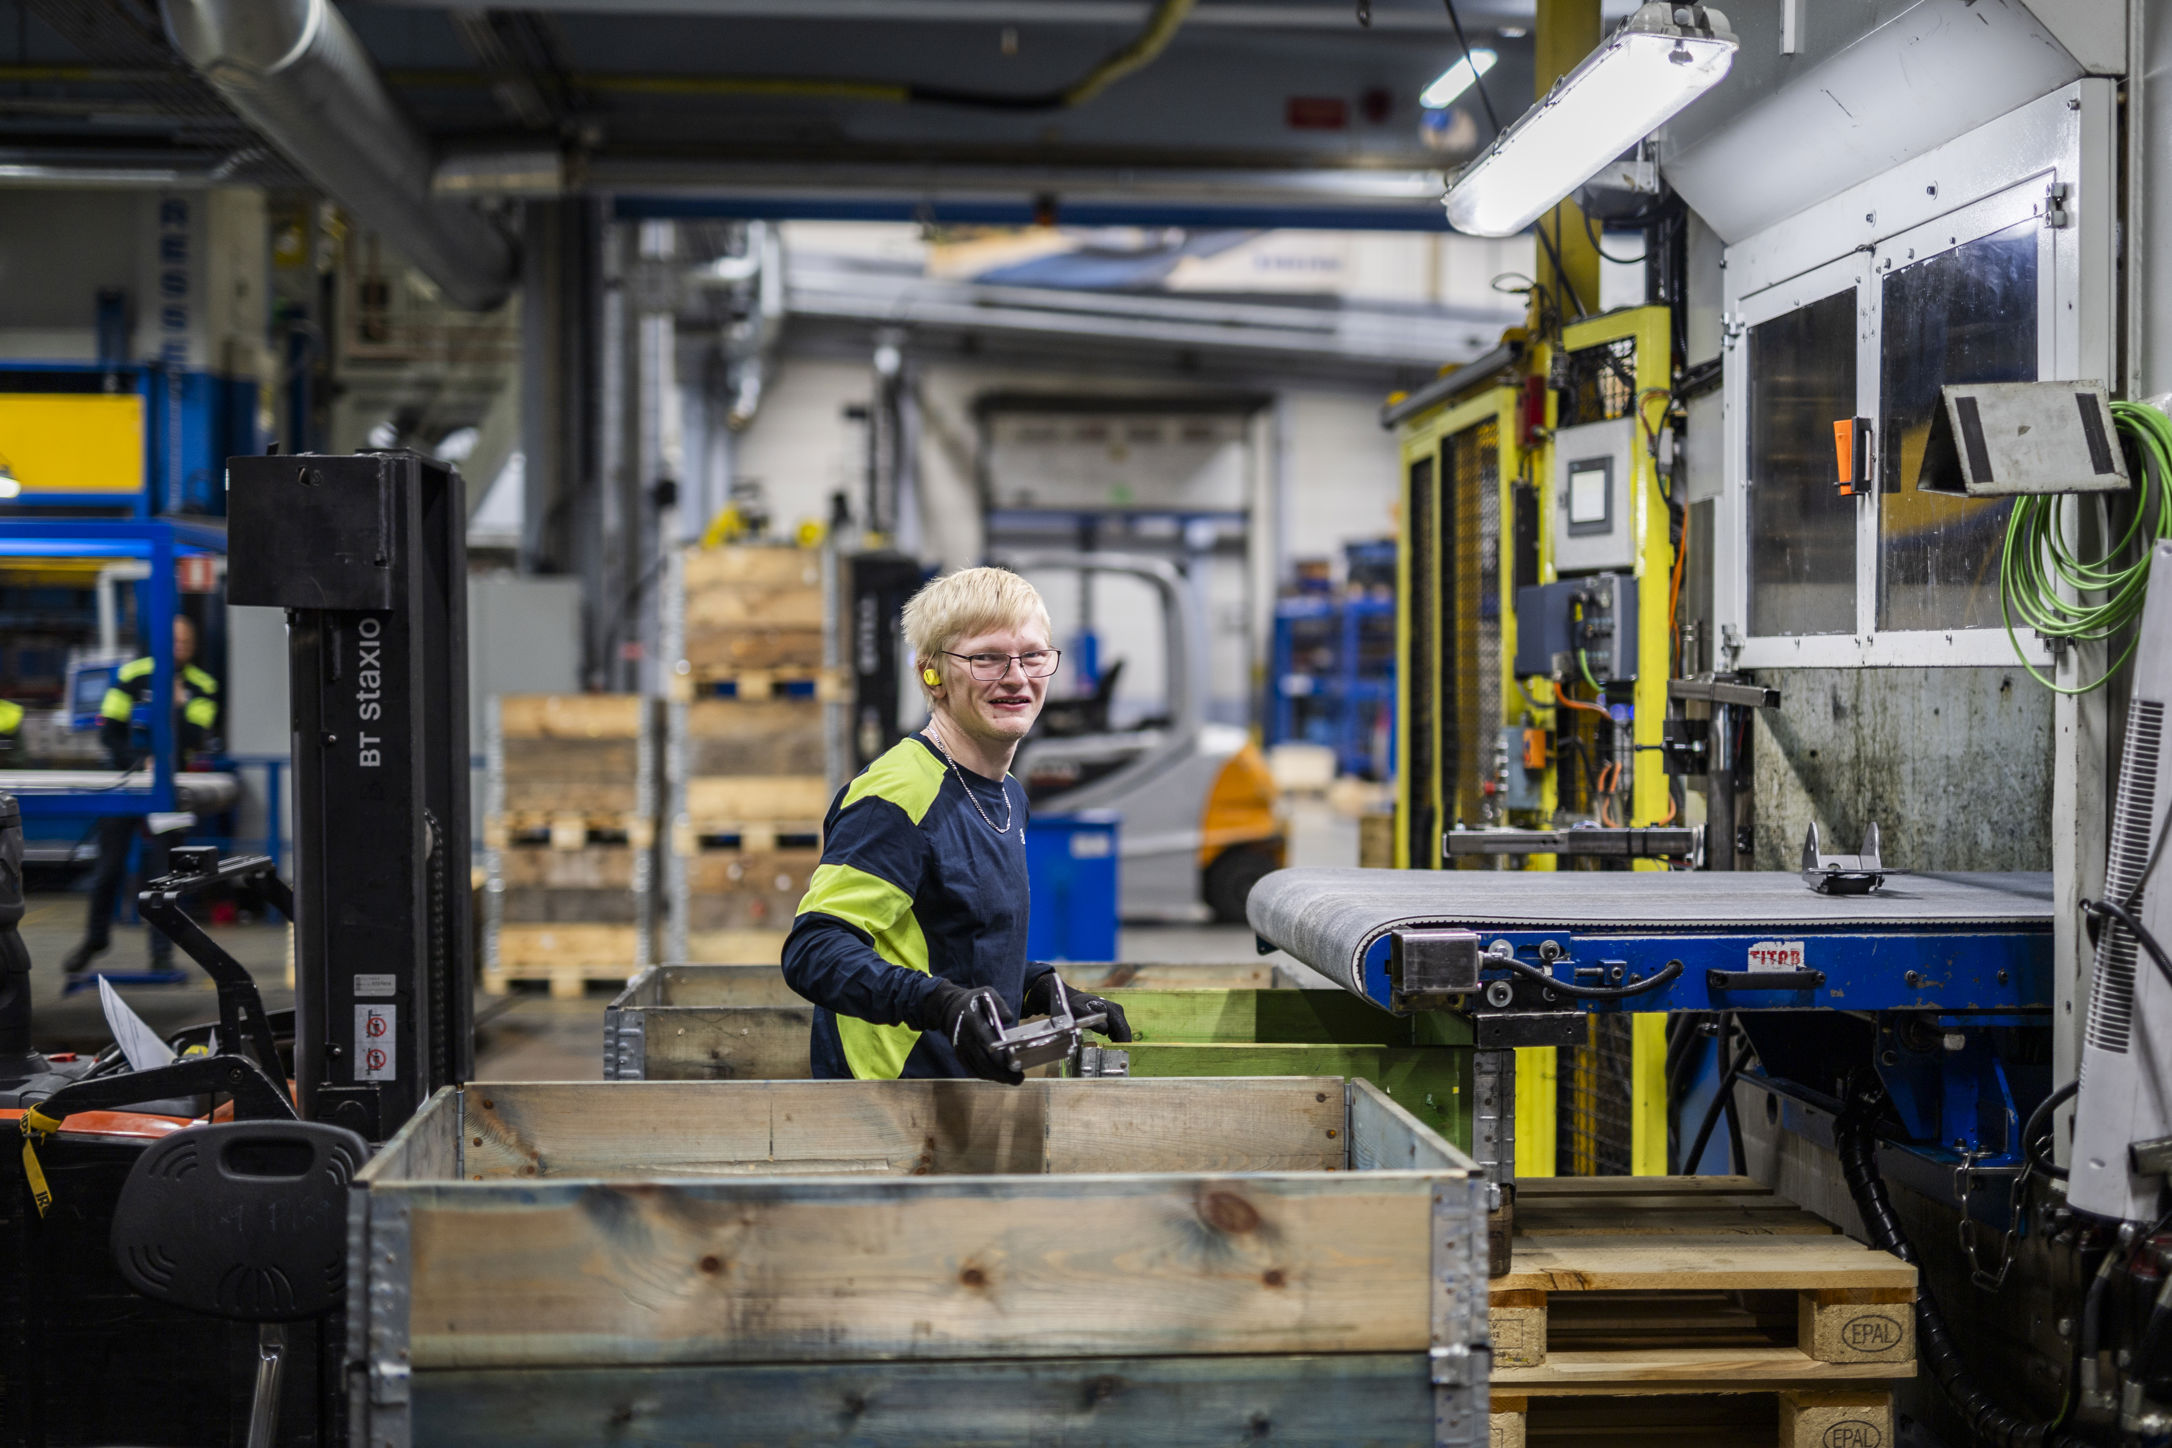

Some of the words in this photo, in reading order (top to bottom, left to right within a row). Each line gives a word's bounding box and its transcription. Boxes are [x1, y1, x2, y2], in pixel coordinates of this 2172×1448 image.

[359, 731, 381, 767] BT
[1852, 1323, 1894, 1345] EPAL
[1832, 1428, 1873, 1448] EPAL
